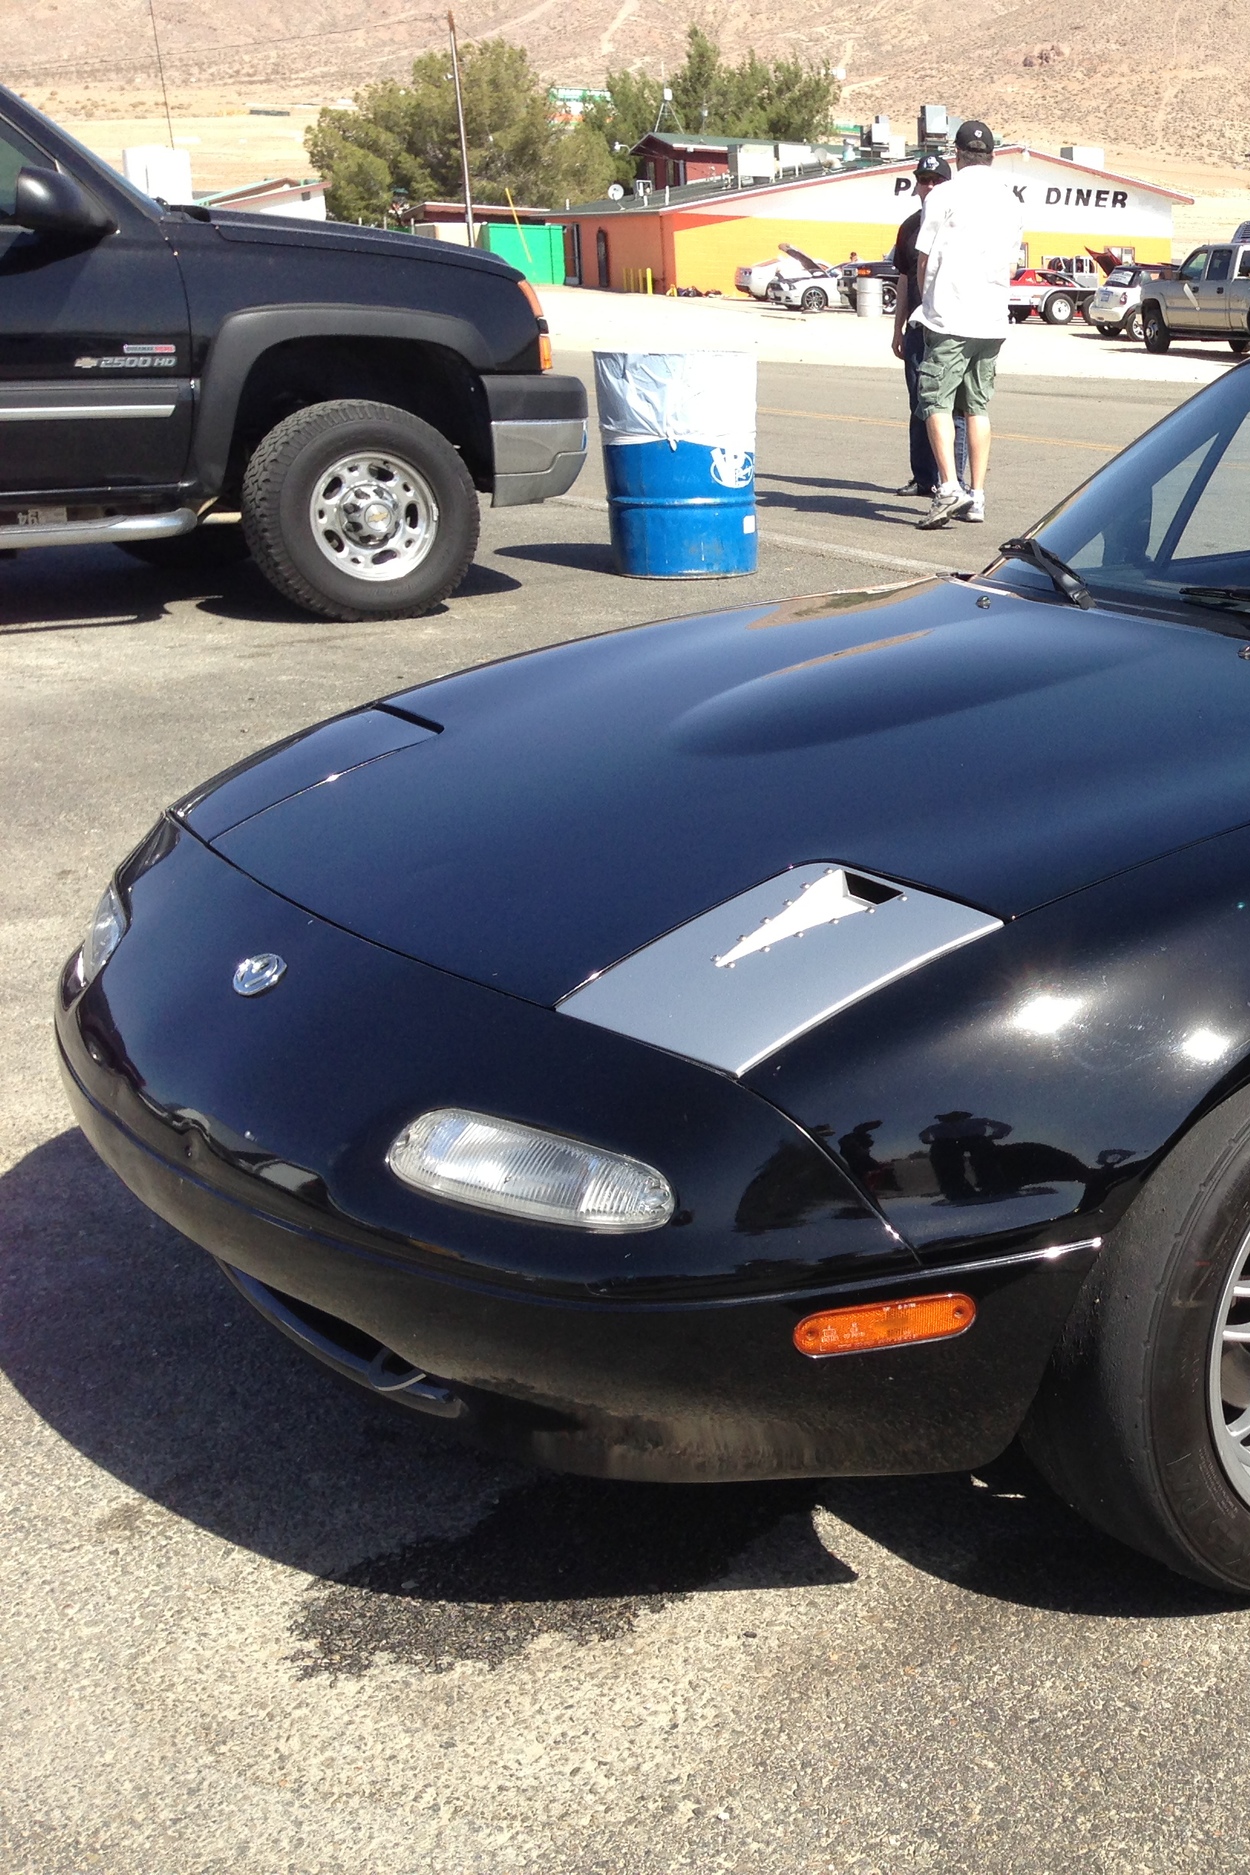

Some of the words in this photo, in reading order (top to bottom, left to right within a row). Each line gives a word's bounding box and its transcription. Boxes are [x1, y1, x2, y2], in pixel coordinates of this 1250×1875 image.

[1045, 187, 1128, 208] DINER
[100, 357, 152, 368] 2500
[153, 356, 177, 367] HD
